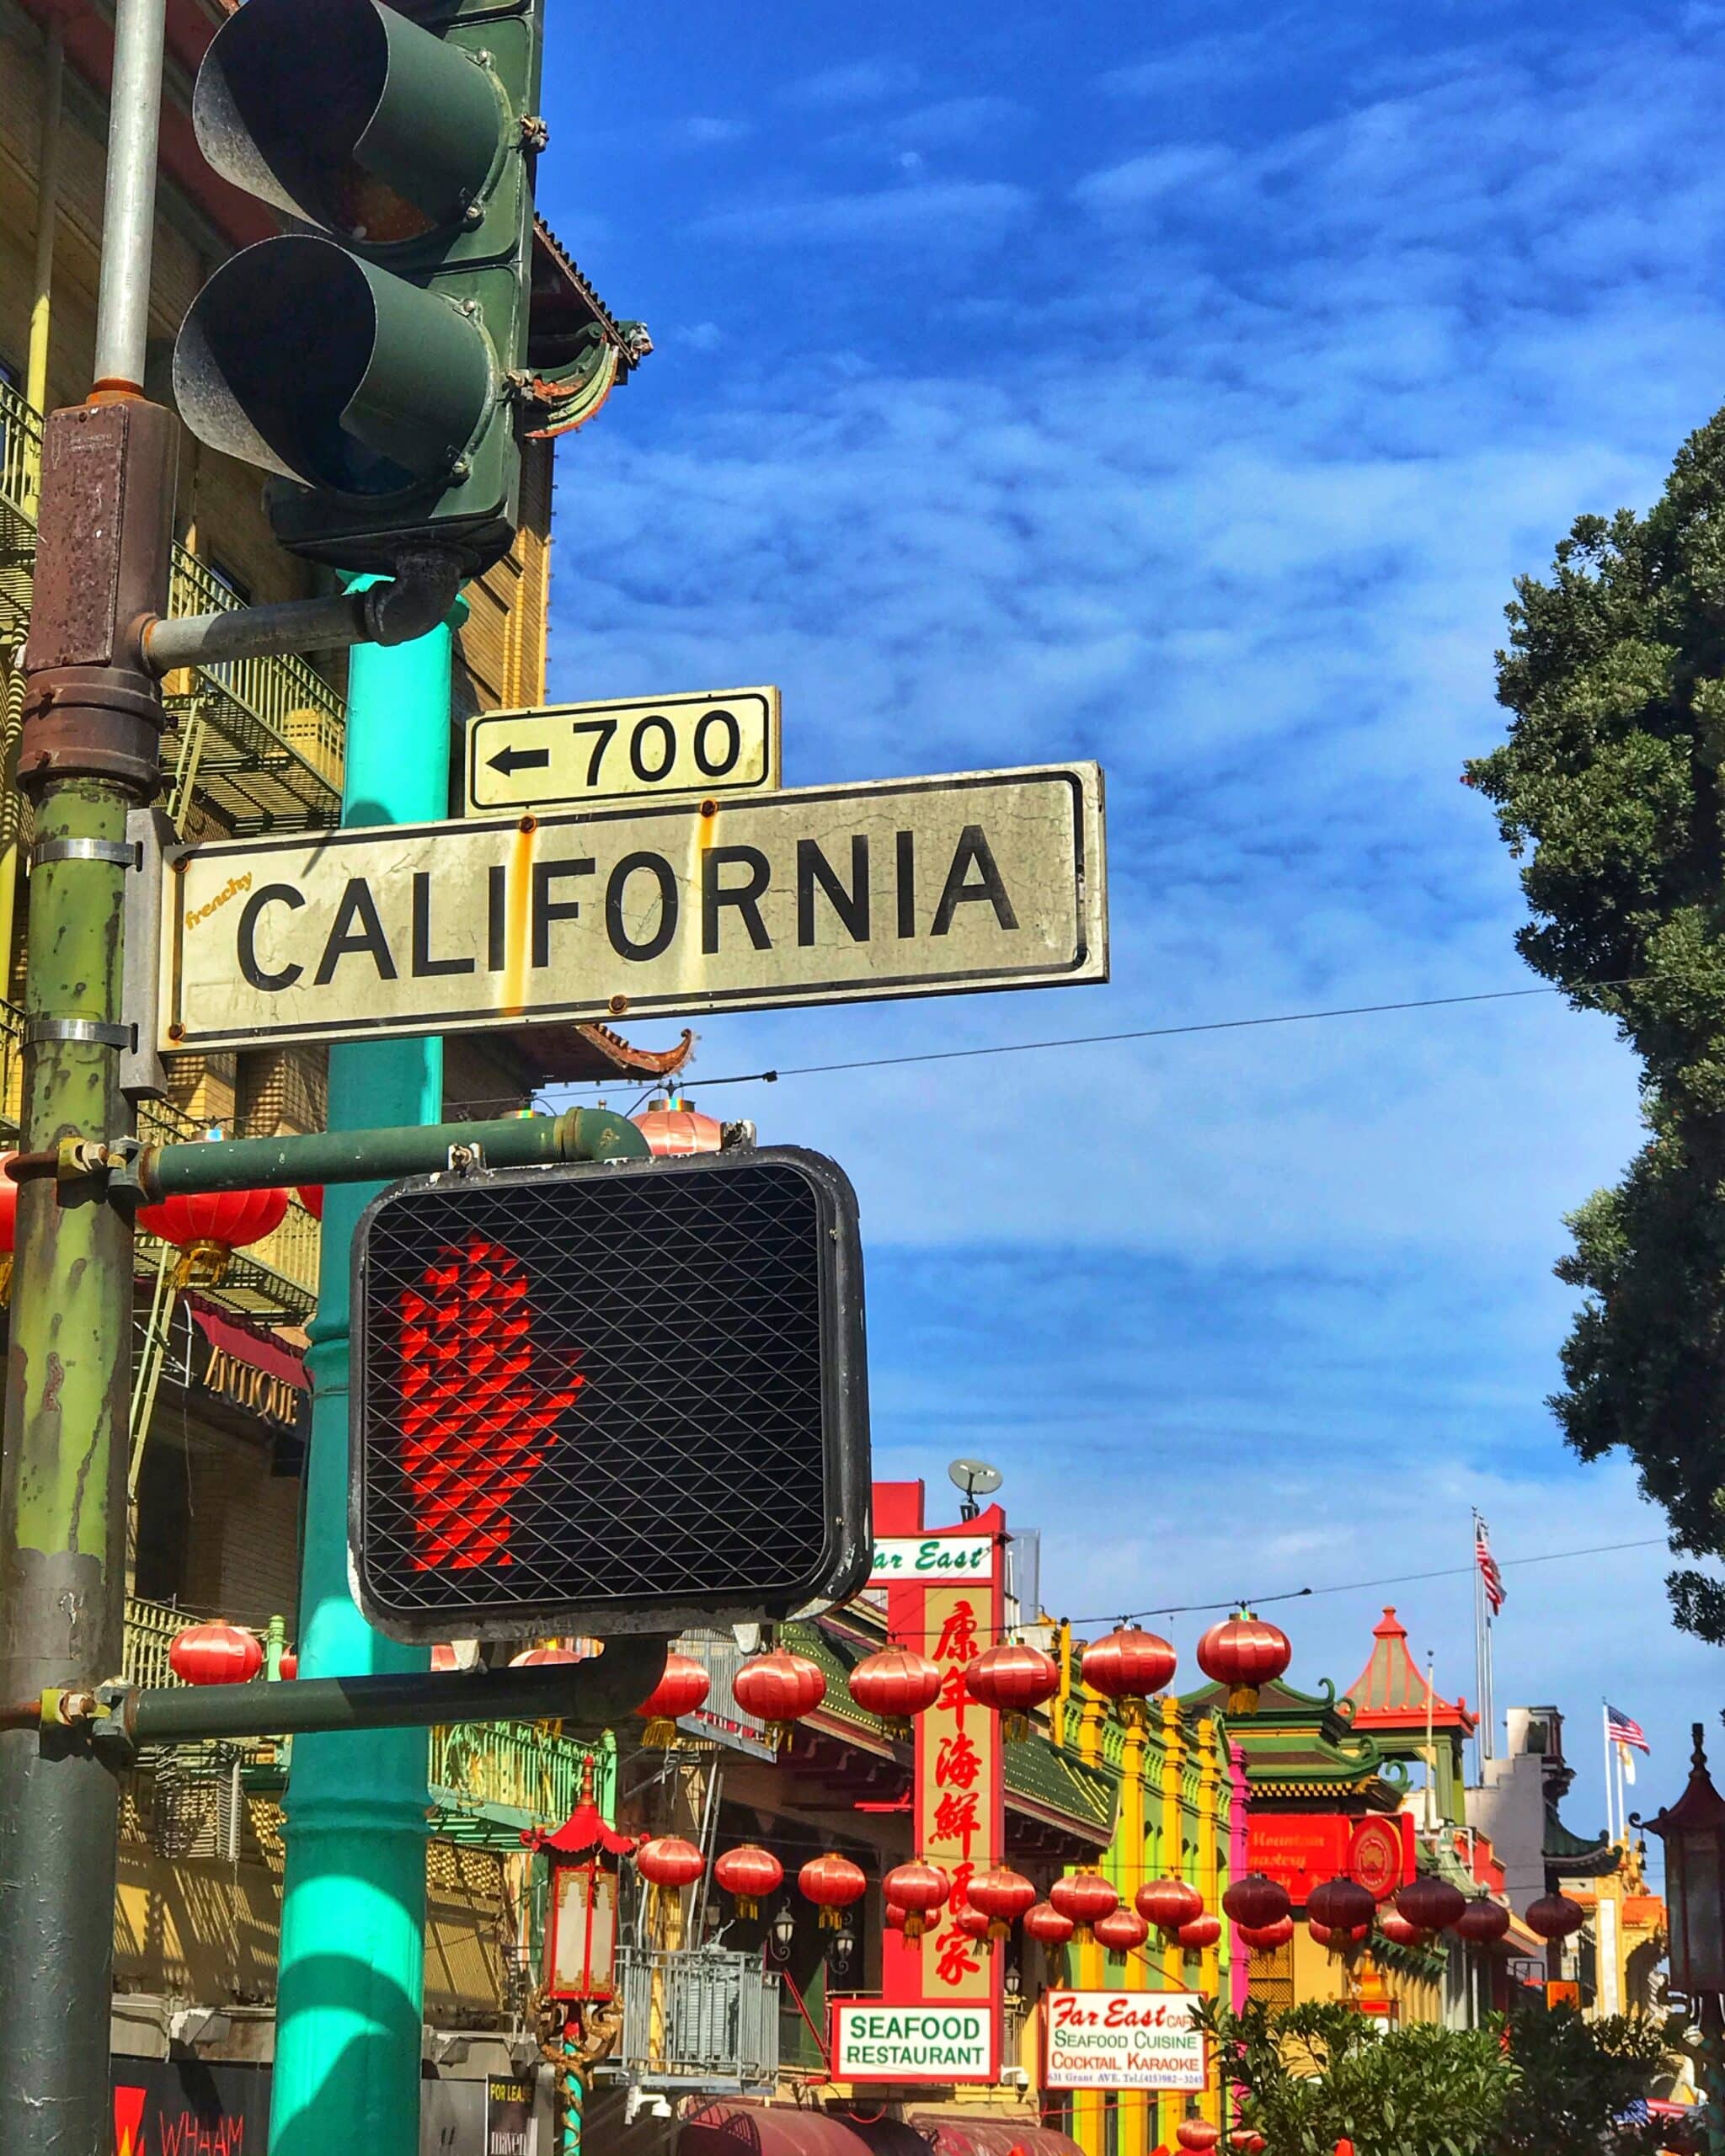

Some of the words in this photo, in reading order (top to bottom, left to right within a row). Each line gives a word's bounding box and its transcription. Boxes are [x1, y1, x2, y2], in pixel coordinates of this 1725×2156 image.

[573, 710, 741, 786] 700
[237, 825, 1020, 992] CALIFORNIA
[203, 1345, 298, 1426] ANTIQUE
[873, 1543, 903, 1570] ar
[915, 1540, 983, 1571] East
[850, 2015, 980, 2040] SEAFOOD
[1053, 1997, 1098, 2028] Far
[1104, 1999, 1166, 2028] East
[847, 2046, 984, 2065] RESTAURANT
[490, 2083, 505, 2101] FOR
[1065, 2073, 1093, 2082] Grant
